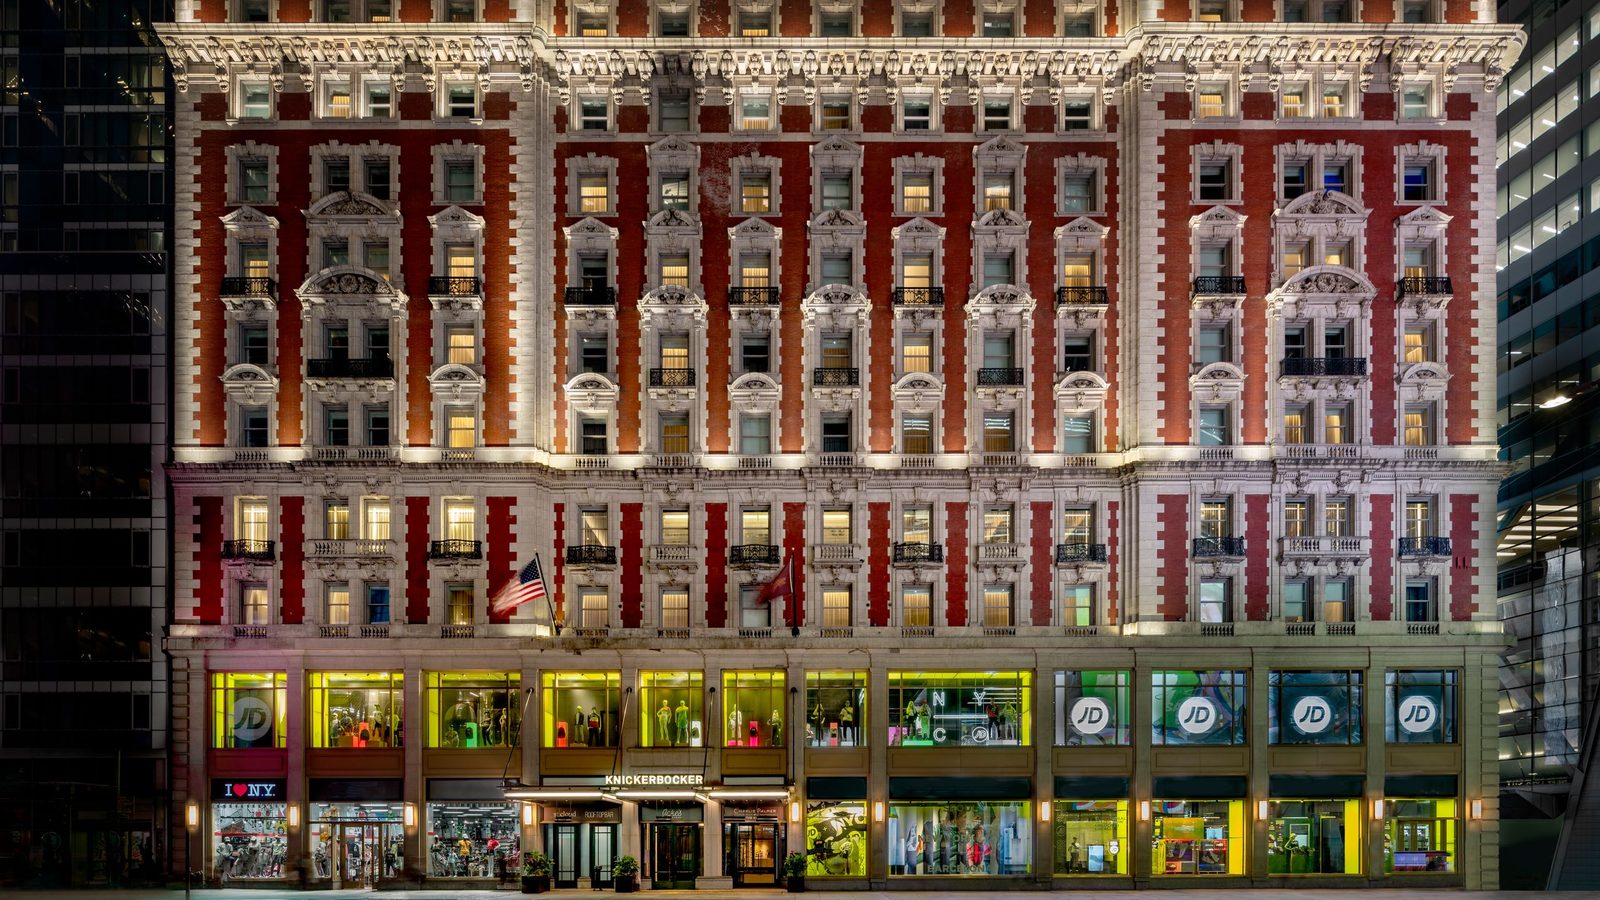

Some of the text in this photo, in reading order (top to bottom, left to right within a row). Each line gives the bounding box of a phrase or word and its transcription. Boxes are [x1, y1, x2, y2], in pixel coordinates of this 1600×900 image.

[234, 707, 267, 730] JD
[1077, 706, 1103, 724] JD
[1184, 706, 1210, 724] JD
[1299, 705, 1326, 723] JD
[1404, 705, 1430, 723] JD
[605, 775, 704, 785] KNICKERBOCKER
[225, 783, 233, 796] I
